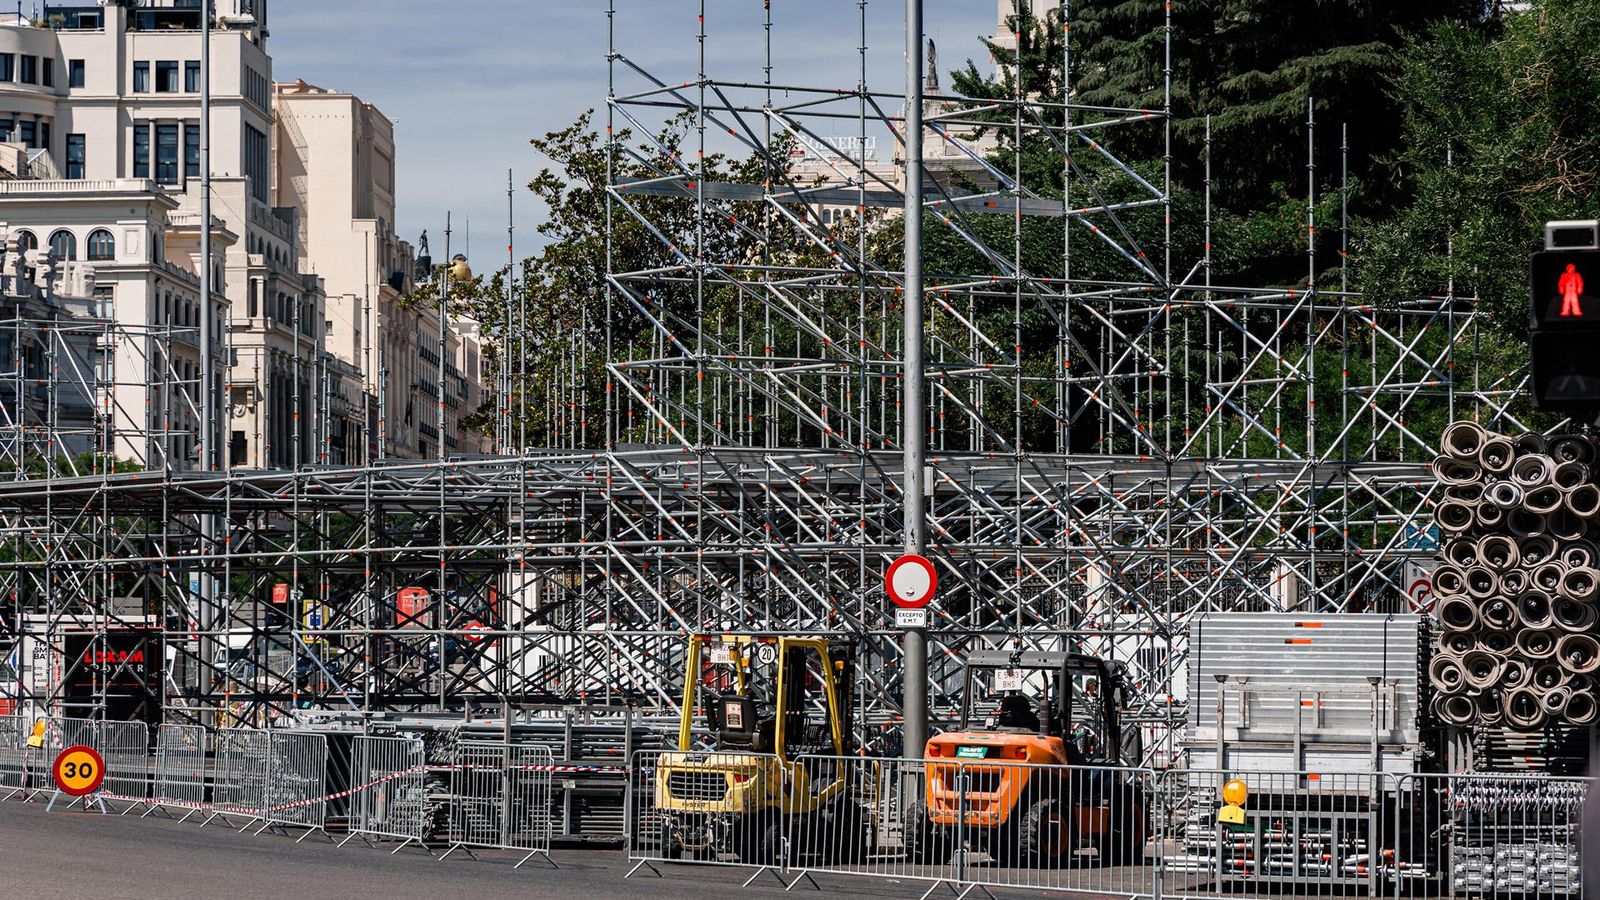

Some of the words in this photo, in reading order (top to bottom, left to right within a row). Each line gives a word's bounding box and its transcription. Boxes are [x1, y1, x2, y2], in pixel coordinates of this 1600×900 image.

[84, 650, 144, 663] LOXAM
[762, 648, 772, 660] 20
[64, 761, 93, 779] 30
